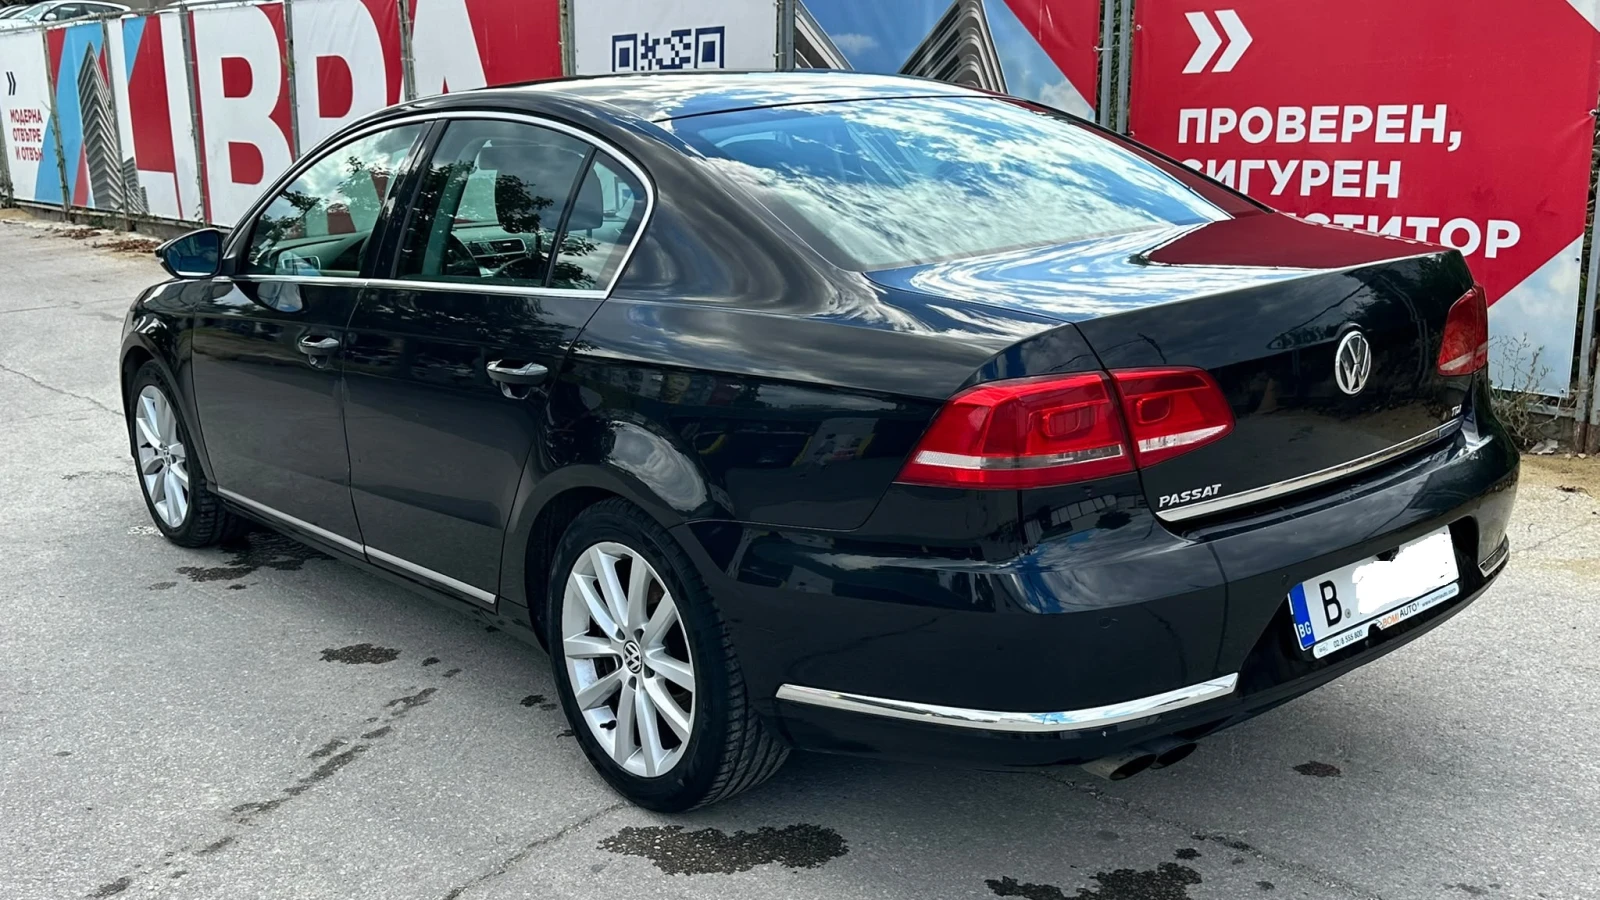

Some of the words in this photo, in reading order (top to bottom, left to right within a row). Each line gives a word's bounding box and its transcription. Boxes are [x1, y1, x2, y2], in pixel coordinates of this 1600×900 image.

[10, 108, 43, 125] МОДЕРНА
[12, 128, 42, 142] ОТВЪТРЕ
[1178, 104, 1462, 152] ПРОВЕРЕН,
[15, 146, 21, 160] И
[1159, 483, 1222, 508] PASSAT
[1298, 621, 1312, 638] BG
